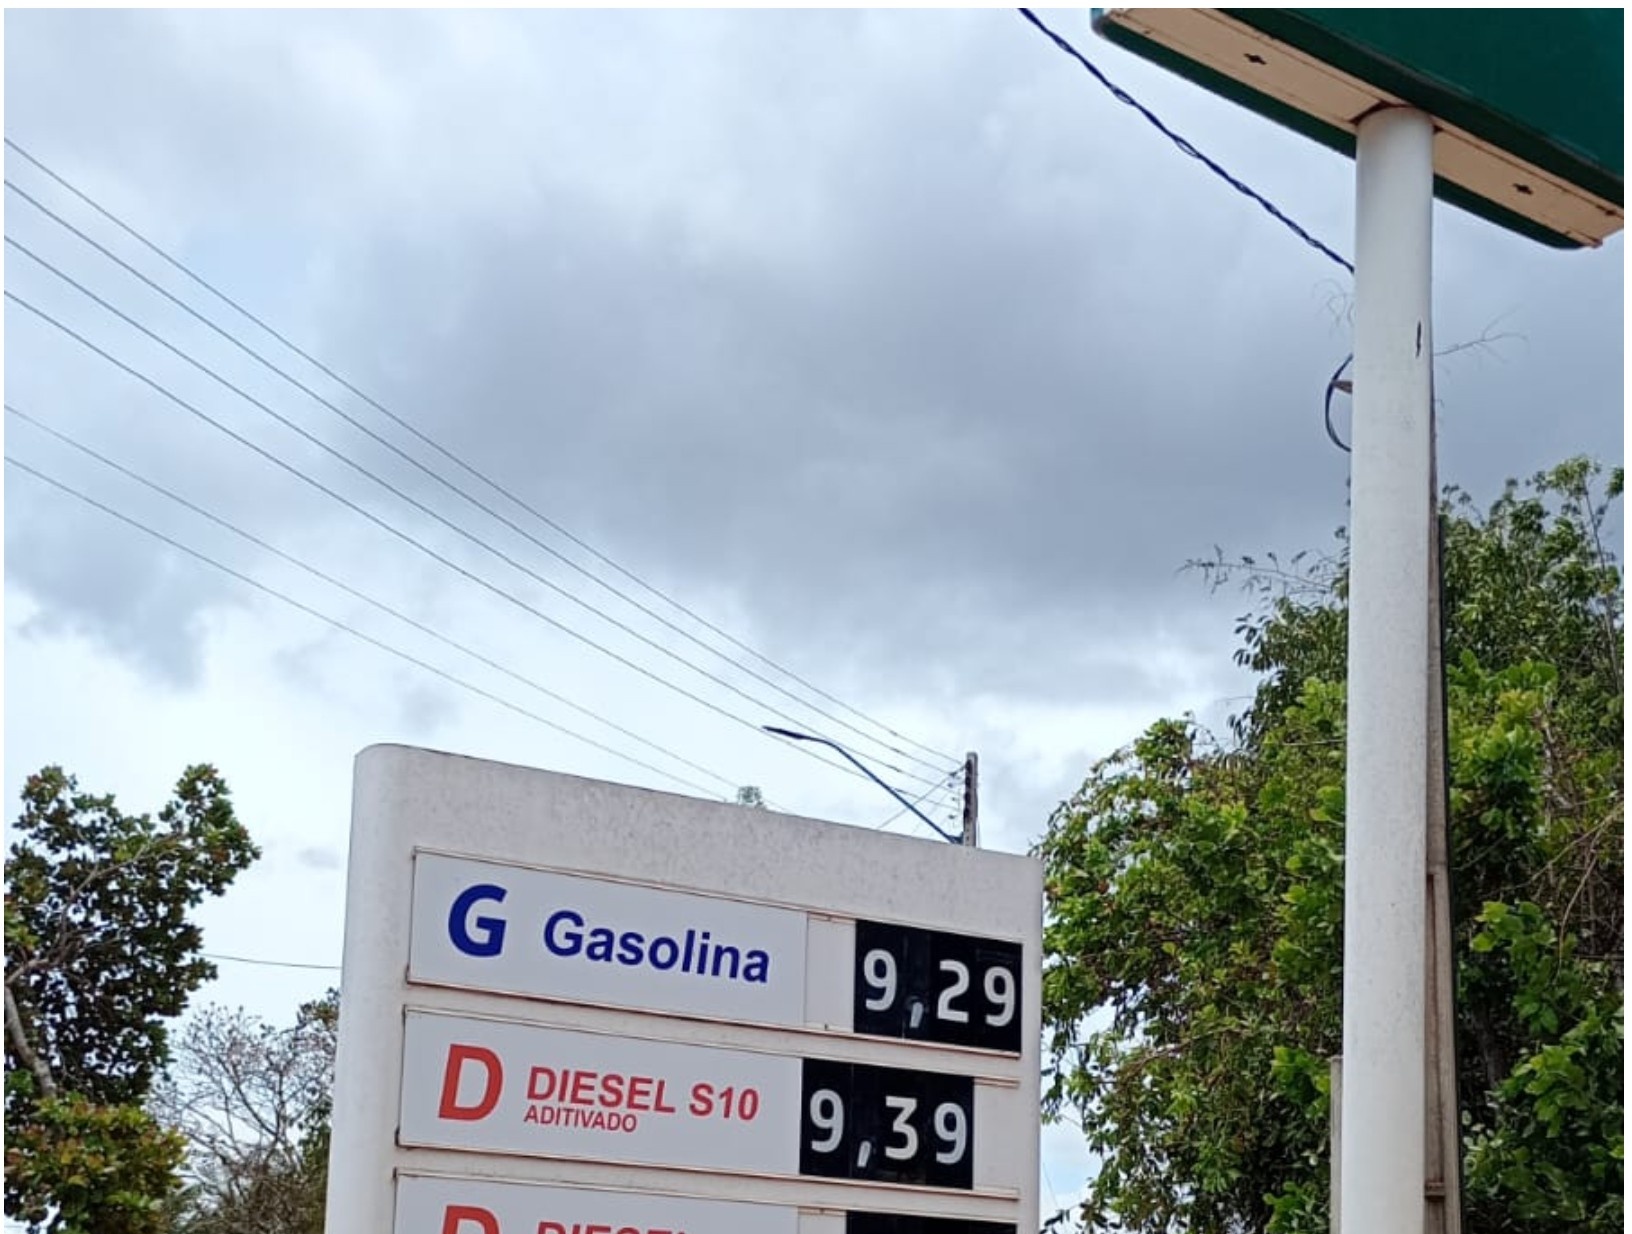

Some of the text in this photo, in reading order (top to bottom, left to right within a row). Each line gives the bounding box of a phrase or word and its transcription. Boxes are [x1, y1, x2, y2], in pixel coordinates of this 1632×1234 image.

[447, 883, 770, 984] G Gasolina
[863, 949, 1015, 1028] 9,29
[438, 1043, 760, 1122] D DIESEL S10
[523, 1105, 637, 1133] ADITIVADO
[809, 1088, 967, 1167] 9,39
